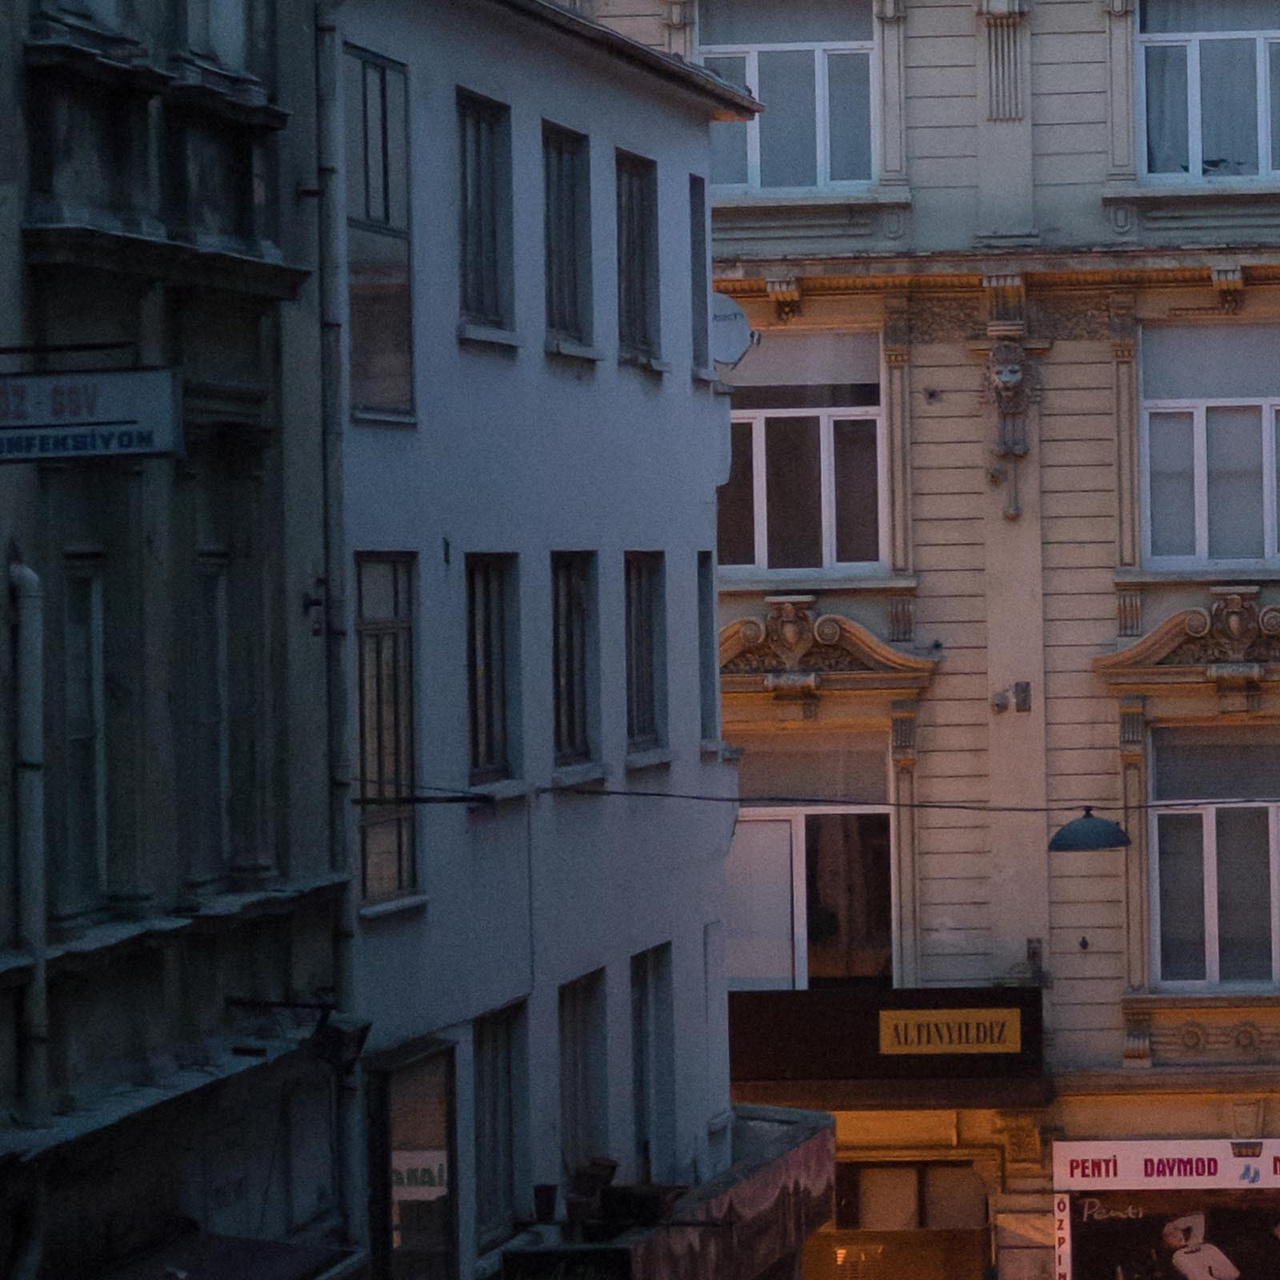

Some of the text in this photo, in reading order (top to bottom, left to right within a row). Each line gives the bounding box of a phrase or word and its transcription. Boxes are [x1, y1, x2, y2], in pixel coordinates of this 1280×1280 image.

[893, 1021, 1007, 1046] ALTINYILDIZ
[1069, 1154, 1118, 1179] PENTİ
[1143, 1156, 1219, 1178] DAYMOD
[1080, 1198, 1143, 1222] Penti
